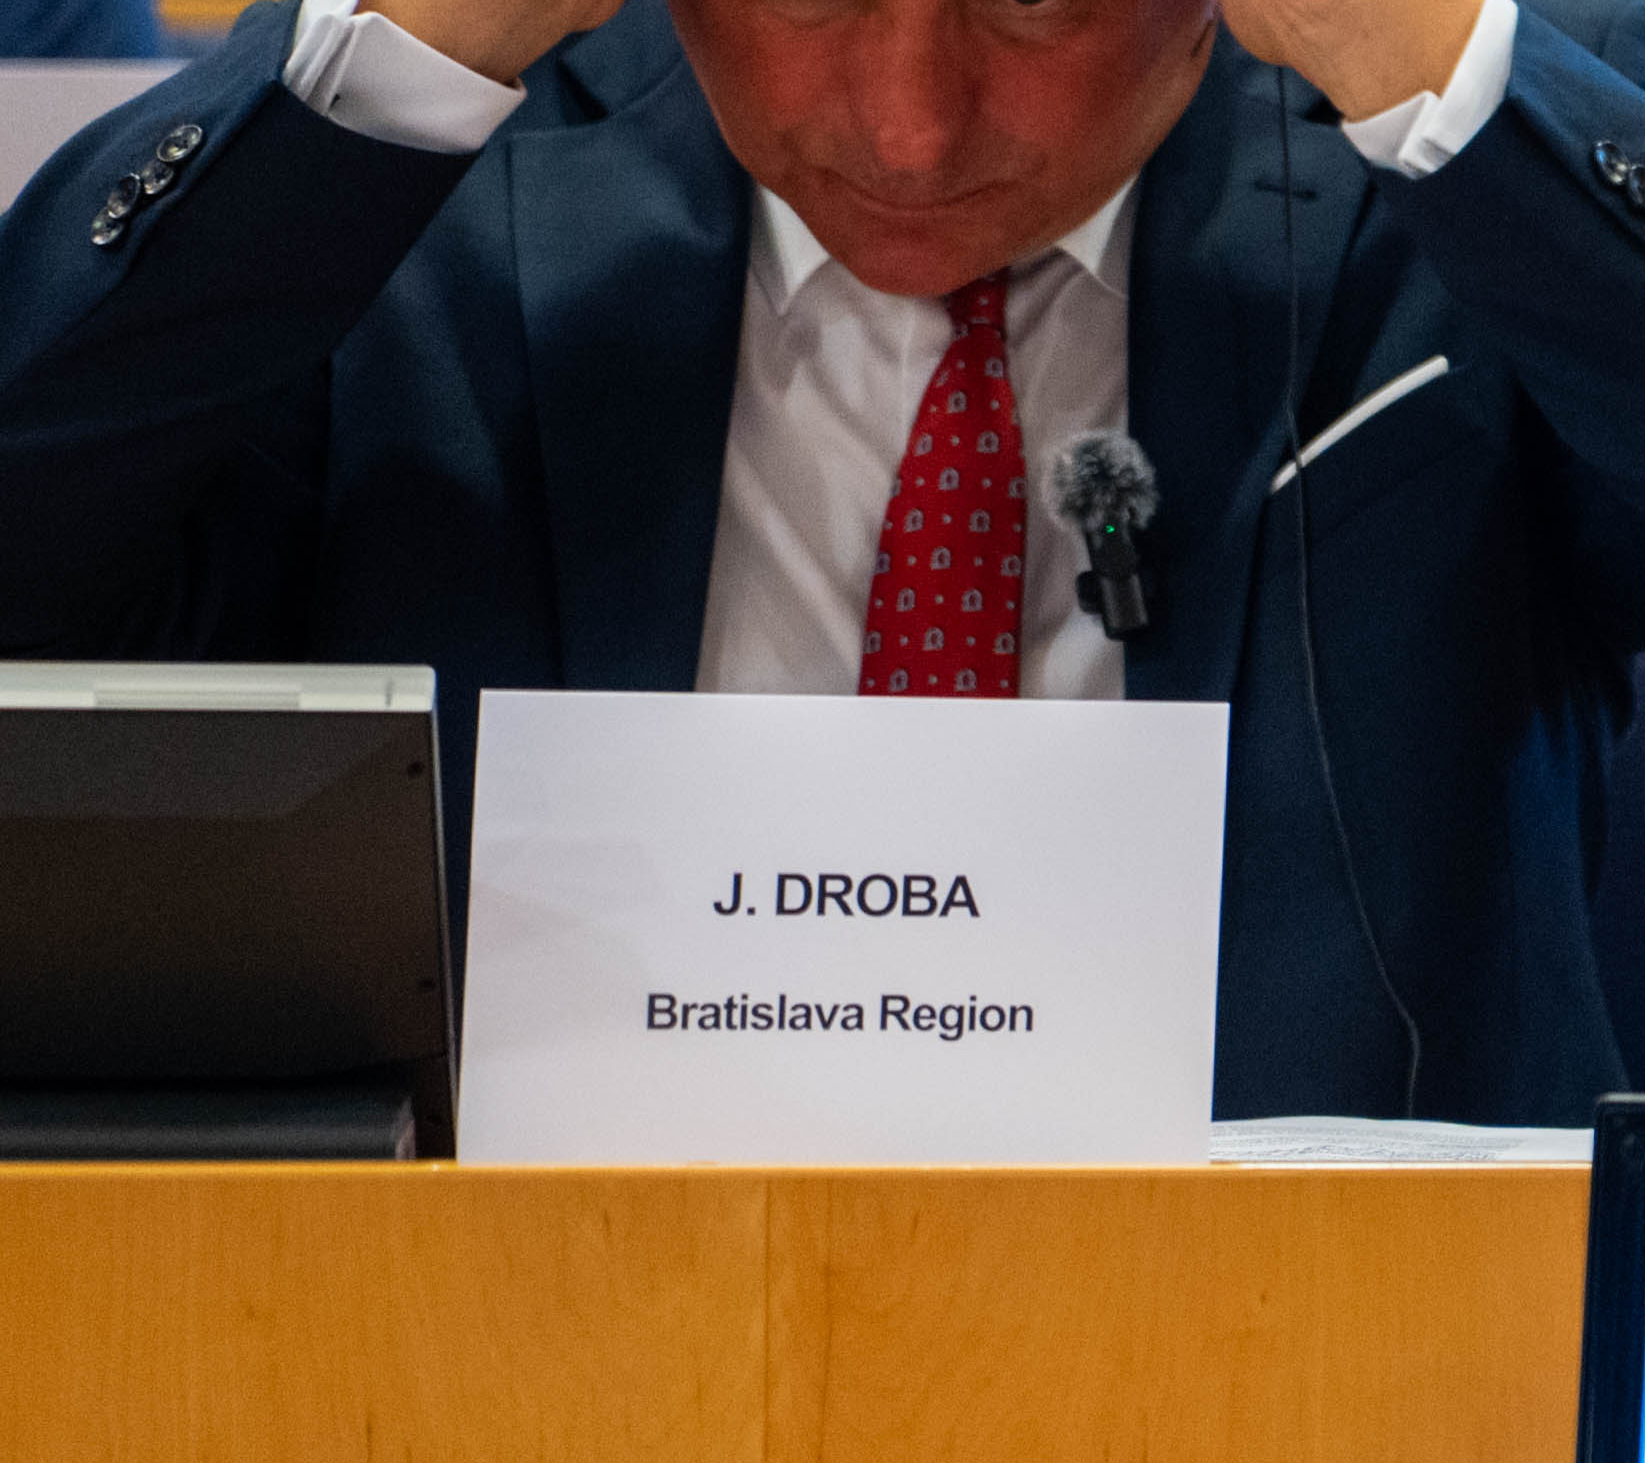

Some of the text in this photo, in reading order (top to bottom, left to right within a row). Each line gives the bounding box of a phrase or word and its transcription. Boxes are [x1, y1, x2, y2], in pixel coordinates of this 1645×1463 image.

[712, 872, 980, 918] J. DROBA
[645, 992, 1035, 1042] Bratislava Region
